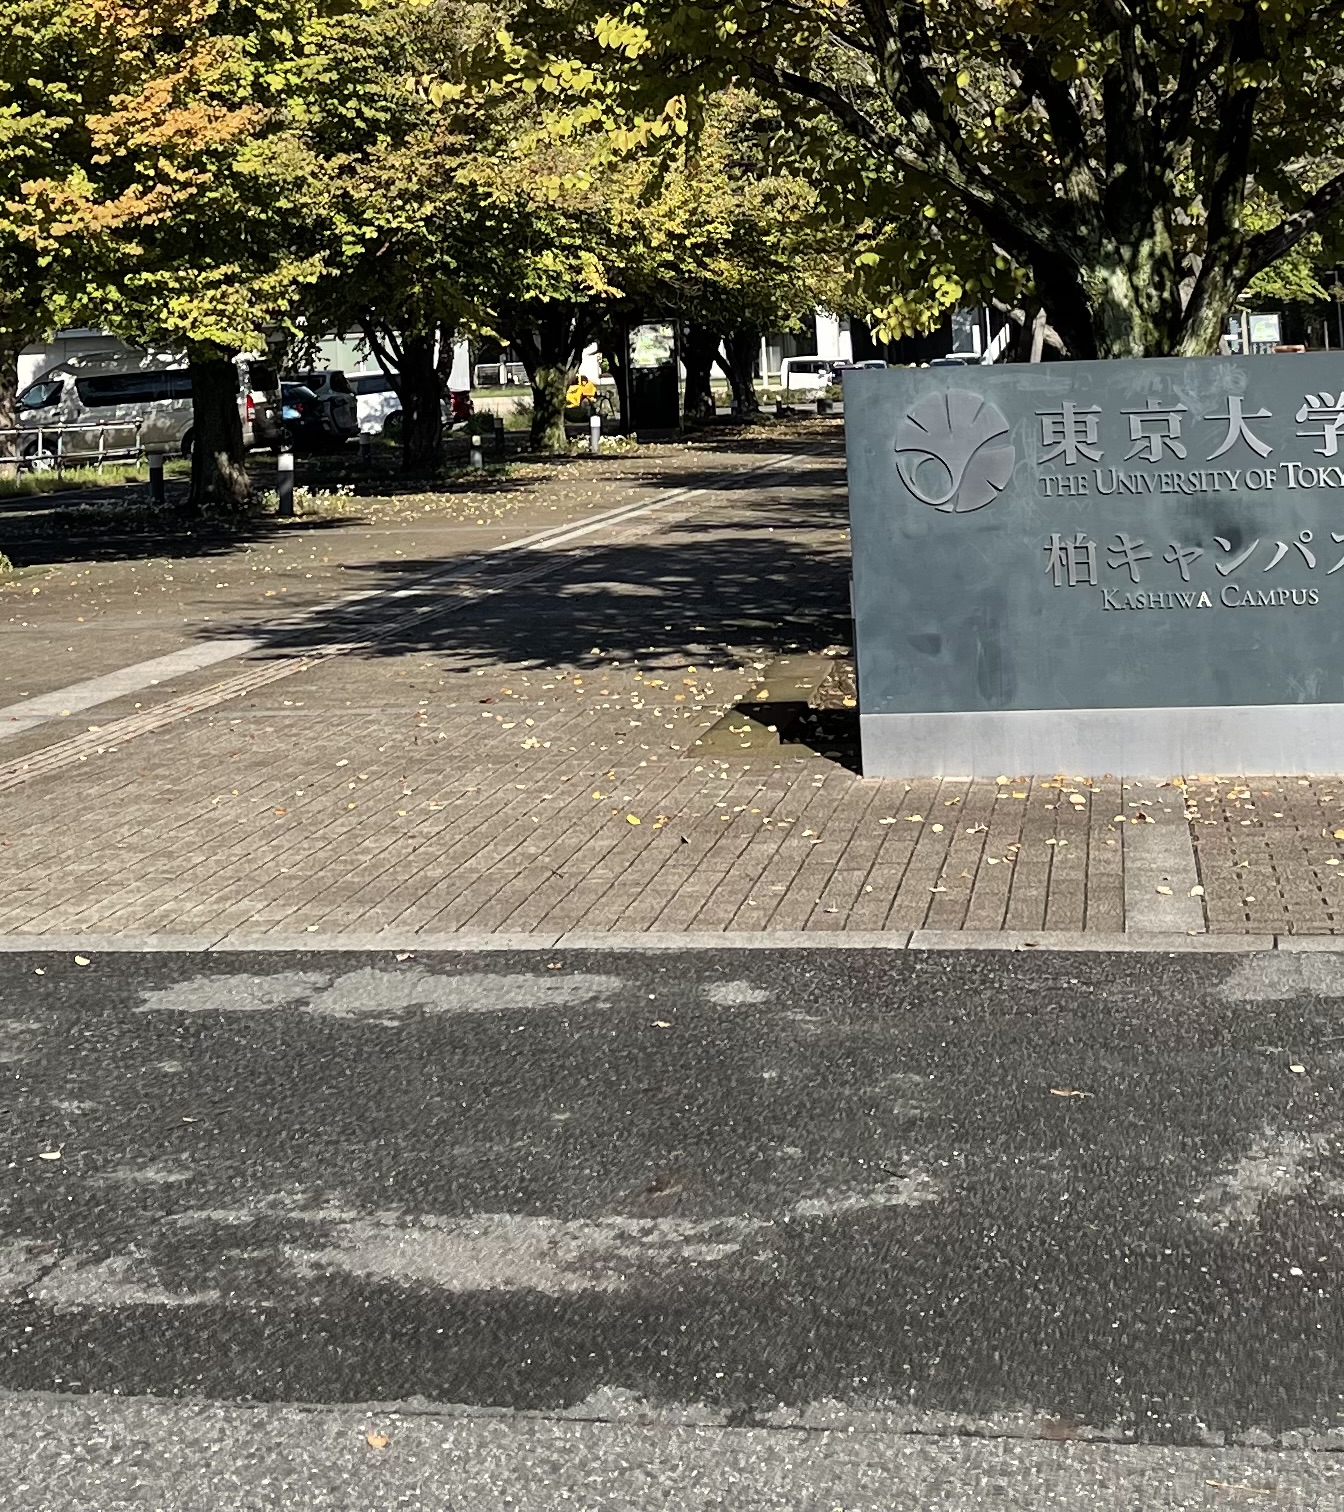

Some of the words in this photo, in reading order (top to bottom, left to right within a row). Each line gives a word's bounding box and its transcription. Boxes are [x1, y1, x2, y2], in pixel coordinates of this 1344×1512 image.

[1039, 475, 1089, 497] THE
[1092, 467, 1242, 495] UNIVERSITY
[1245, 468, 1277, 490] OF
[1102, 588, 1212, 611] KASHIWA
[1220, 585, 1320, 608] CAMPUS
